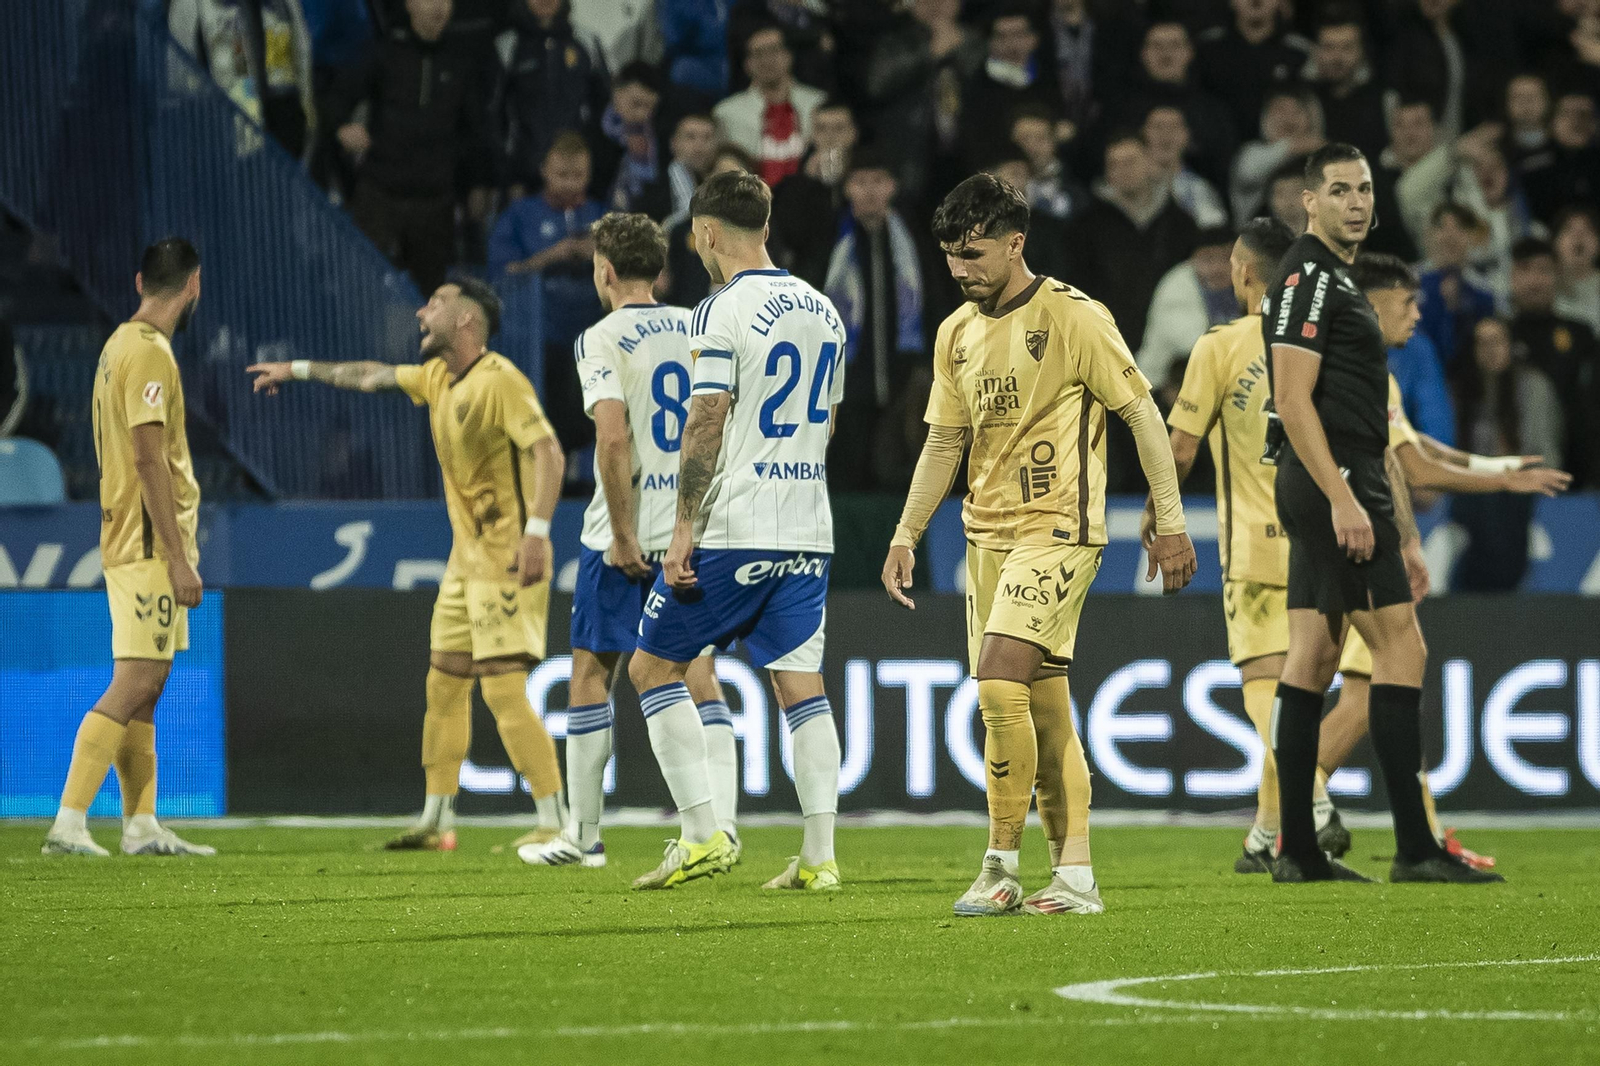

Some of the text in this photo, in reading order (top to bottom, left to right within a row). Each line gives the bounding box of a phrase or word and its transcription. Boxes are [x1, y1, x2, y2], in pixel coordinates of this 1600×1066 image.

[651, 361, 691, 453] 8
[759, 340, 838, 439] 24
[157, 595, 173, 628] 9
[1002, 583, 1051, 606] MGS
